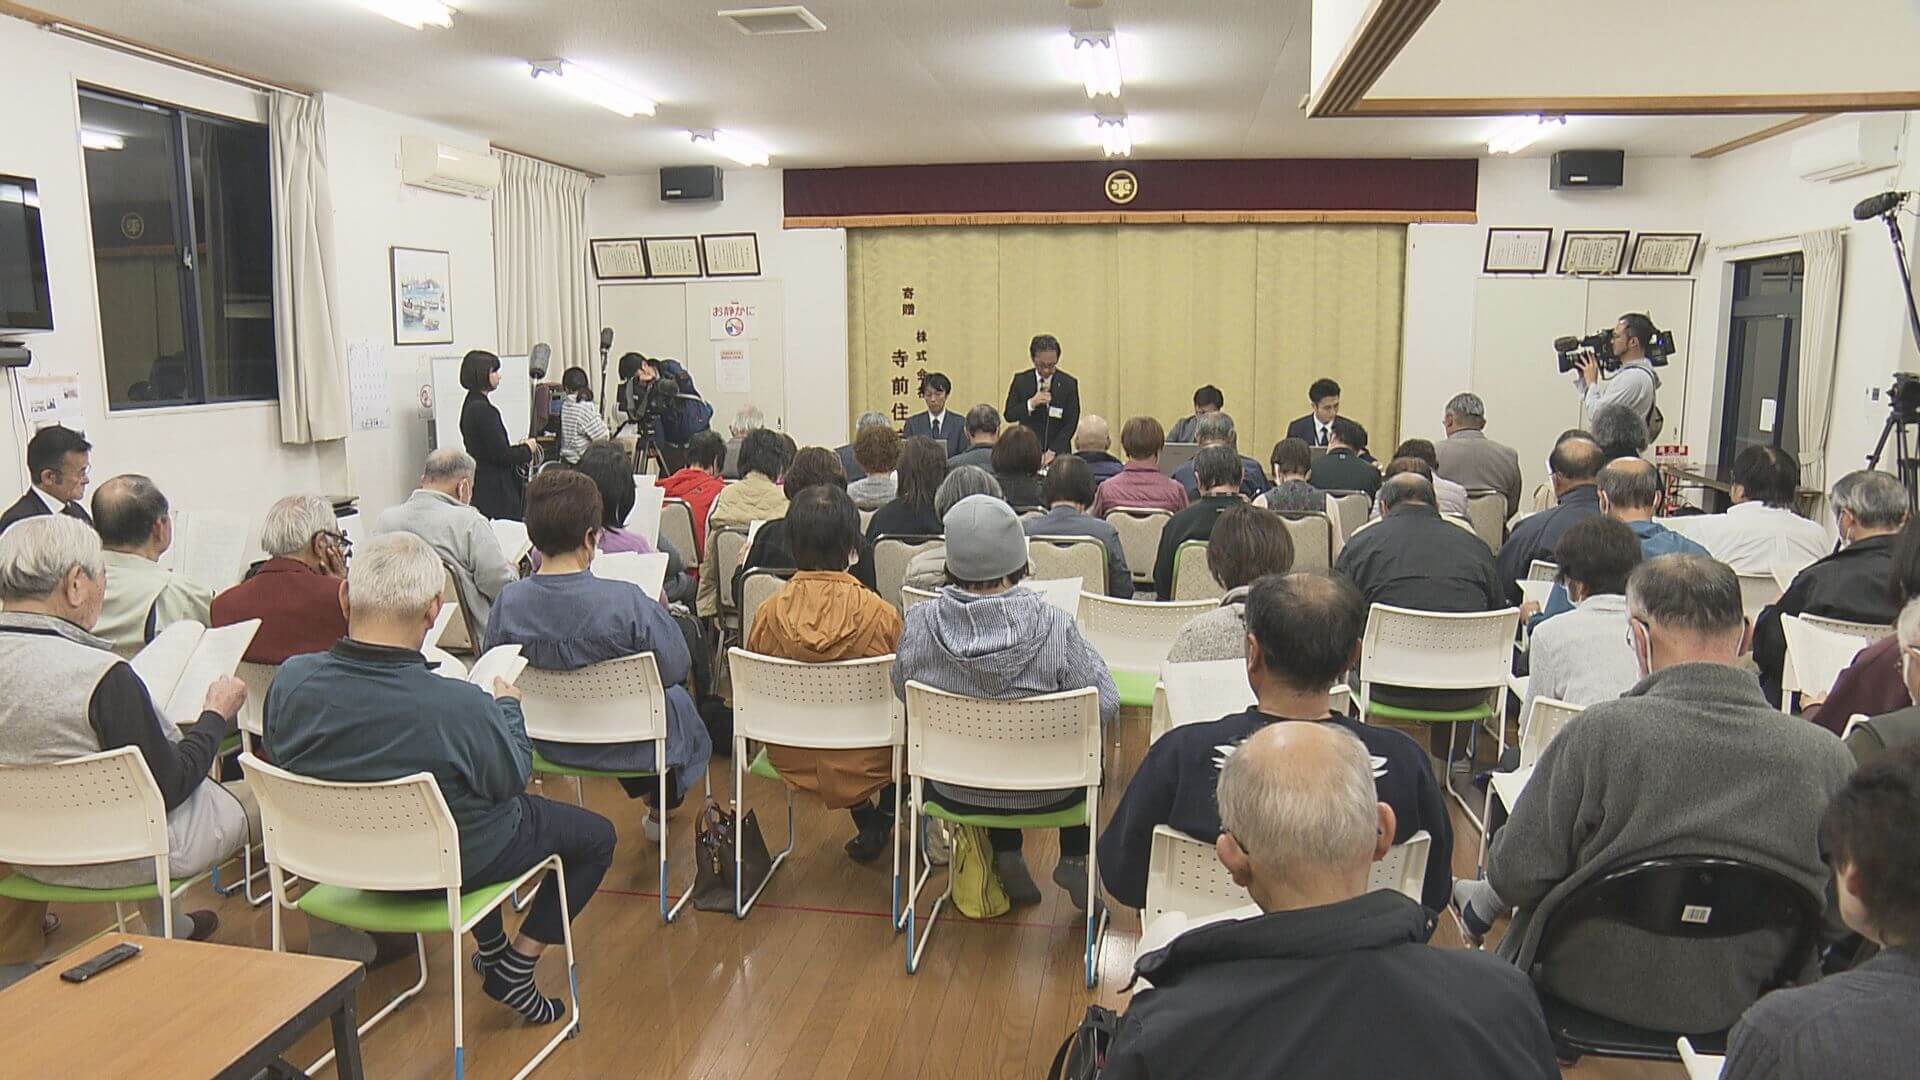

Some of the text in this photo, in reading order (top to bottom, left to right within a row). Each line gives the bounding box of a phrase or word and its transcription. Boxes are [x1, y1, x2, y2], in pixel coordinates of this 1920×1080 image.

[712, 305, 756, 317] お静かに
[902, 287, 915, 316] 寄贈
